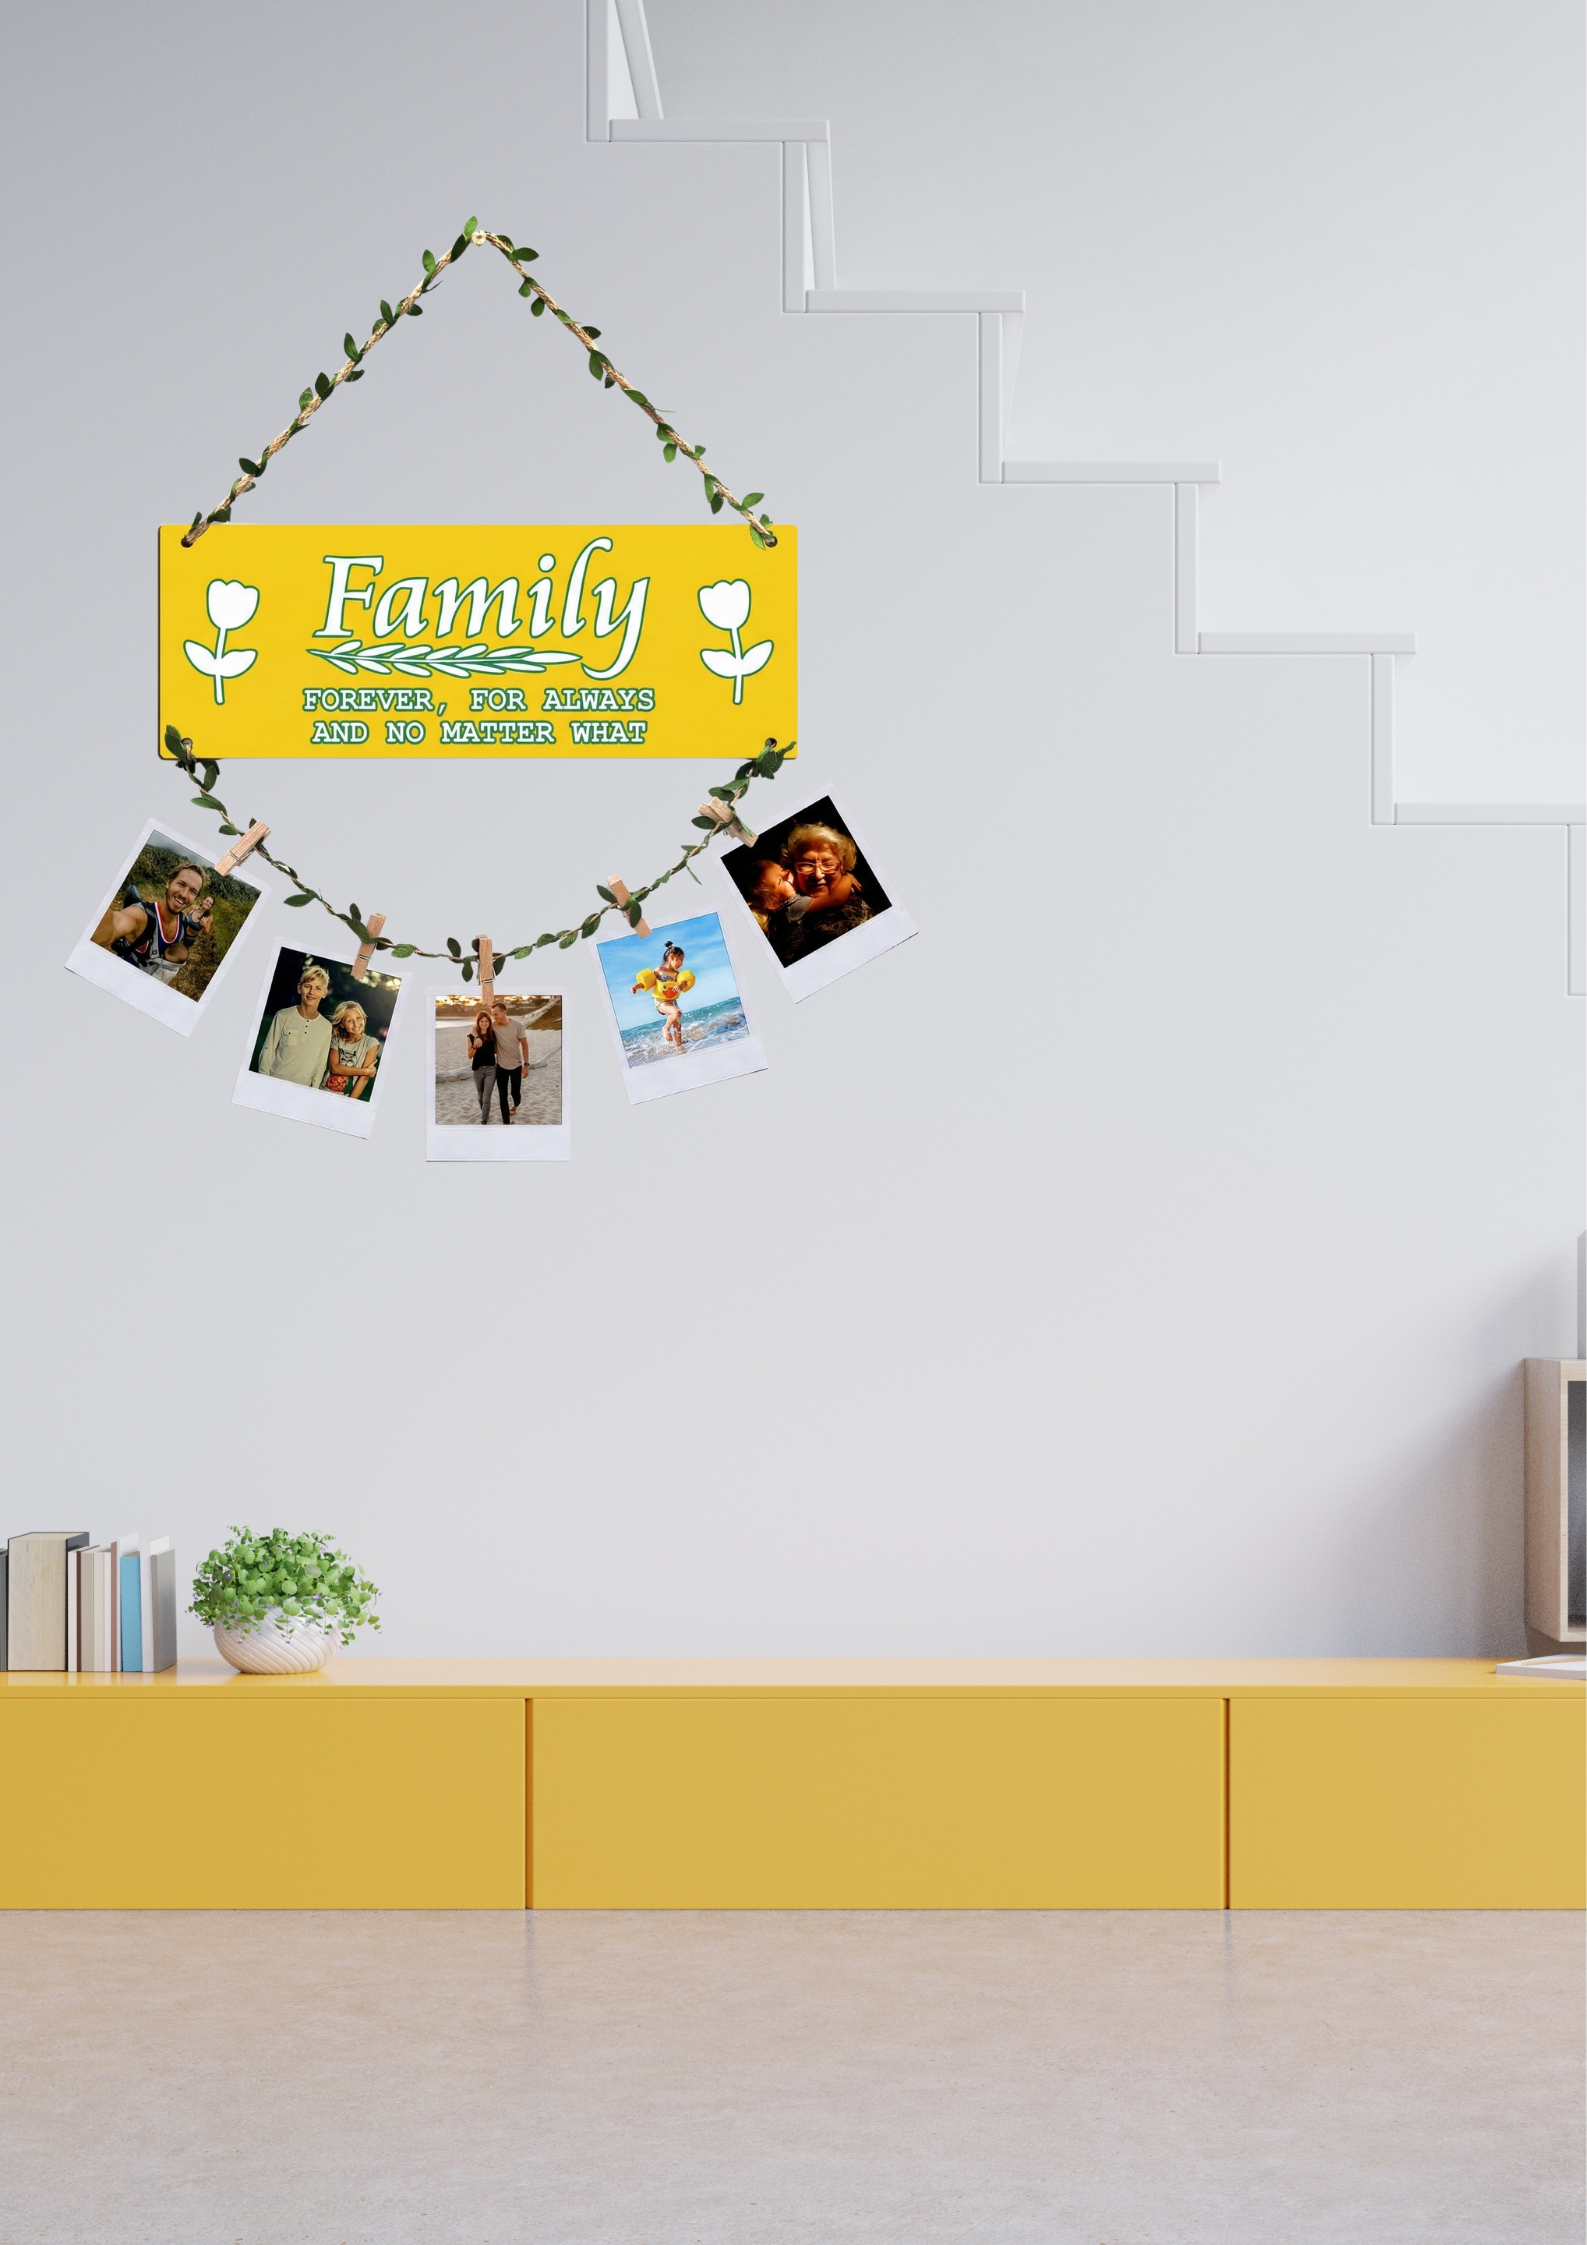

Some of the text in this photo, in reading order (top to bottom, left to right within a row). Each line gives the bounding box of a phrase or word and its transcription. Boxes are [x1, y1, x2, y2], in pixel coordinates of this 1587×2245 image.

[311, 536, 651, 681] Family
[302, 687, 656, 717] FOREVER, FOR ALWAYS
[310, 720, 648, 745] AND NO MATTER WHAT
